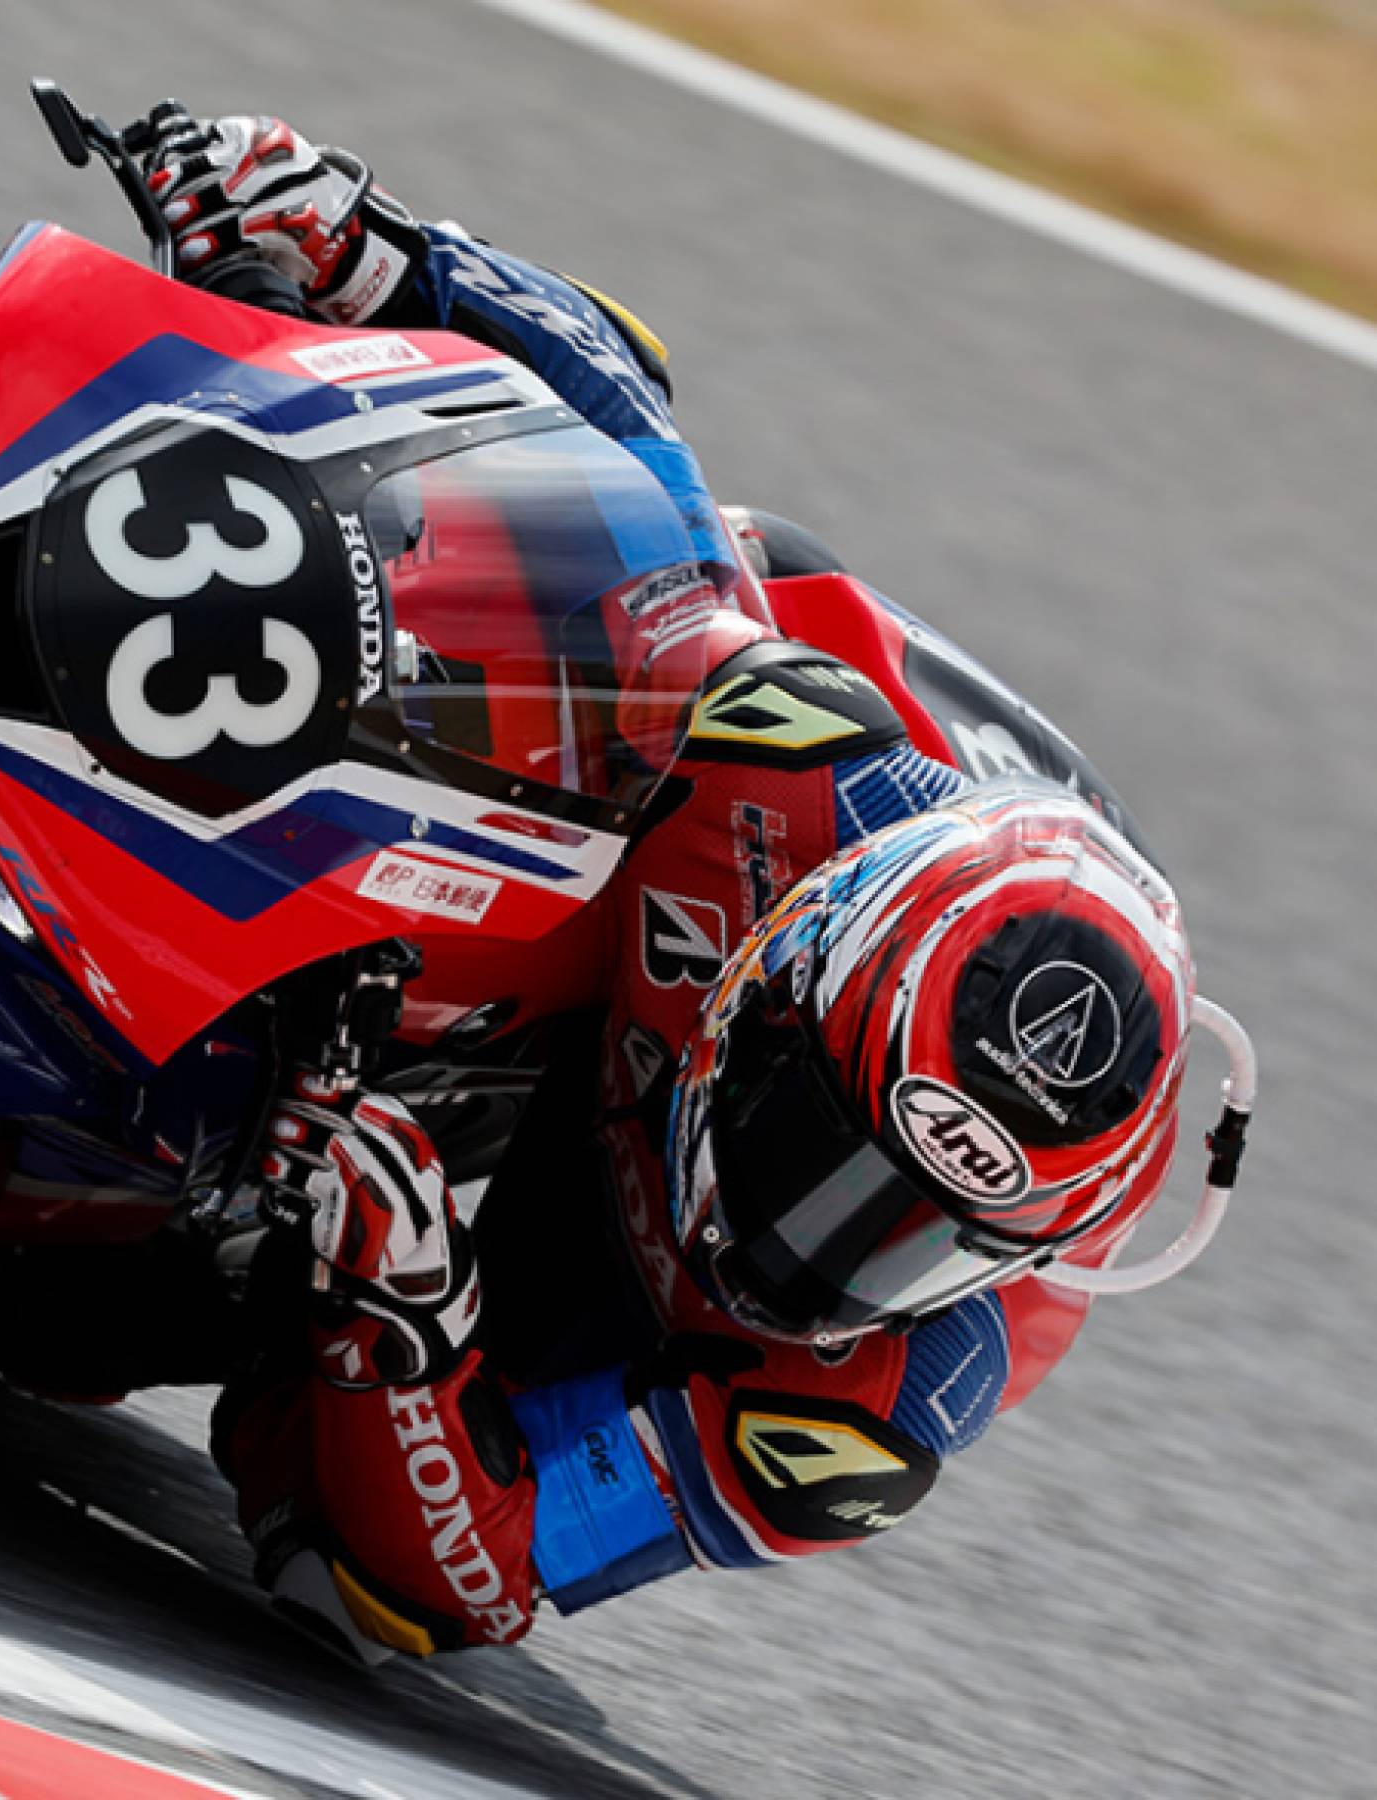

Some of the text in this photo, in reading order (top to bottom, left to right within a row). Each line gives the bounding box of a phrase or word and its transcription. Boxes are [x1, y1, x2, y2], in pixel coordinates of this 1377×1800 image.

[85, 467, 321, 761] 33
[336, 511, 383, 704] HONDA
[905, 1101, 1018, 1188] Arai
[387, 1385, 525, 1643] HONDA
